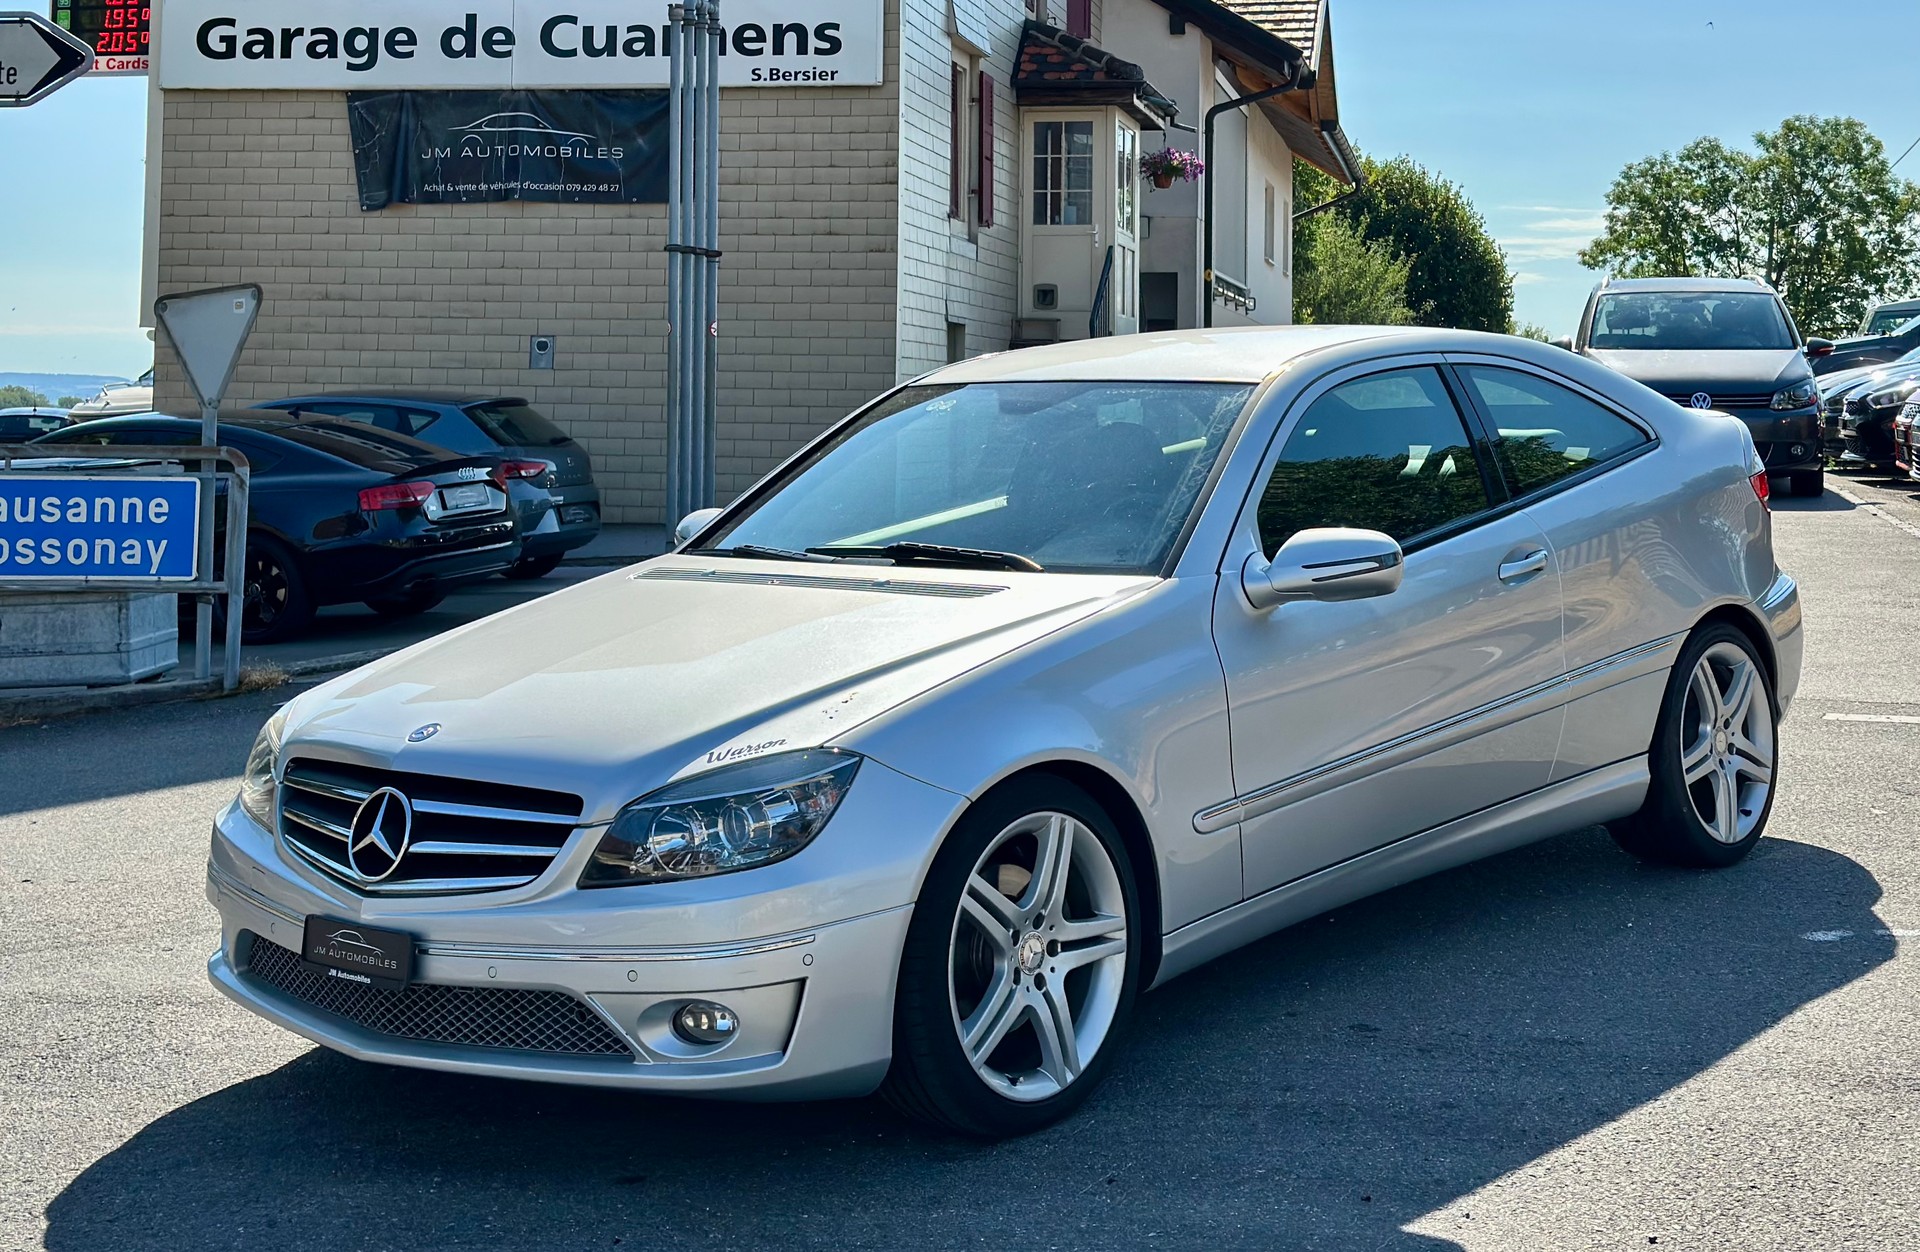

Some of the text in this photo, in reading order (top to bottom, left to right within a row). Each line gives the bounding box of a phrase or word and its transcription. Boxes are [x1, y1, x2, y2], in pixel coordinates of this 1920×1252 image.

[196, 17, 418, 71] Garage
[440, 13, 516, 59] de
[106, 58, 149, 70] Cards
[751, 67, 838, 82] S.Bersier
[421, 145, 624, 159] JM AUTOMOBILES
[424, 184, 445, 192] Achat
[447, 183, 454, 191] &
[455, 183, 477, 191] vente
[478, 182, 488, 191] de
[522, 181, 565, 191] d'occasion
[566, 184, 581, 192] 079
[582, 184, 597, 192] 429
[598, 184, 609, 192] 48
[609, 184, 619, 192] 27
[706, 738, 788, 764] Warson
[313, 946, 397, 969] JM AUTOMOBILES
[328, 968, 371, 984] JM Automobiles
